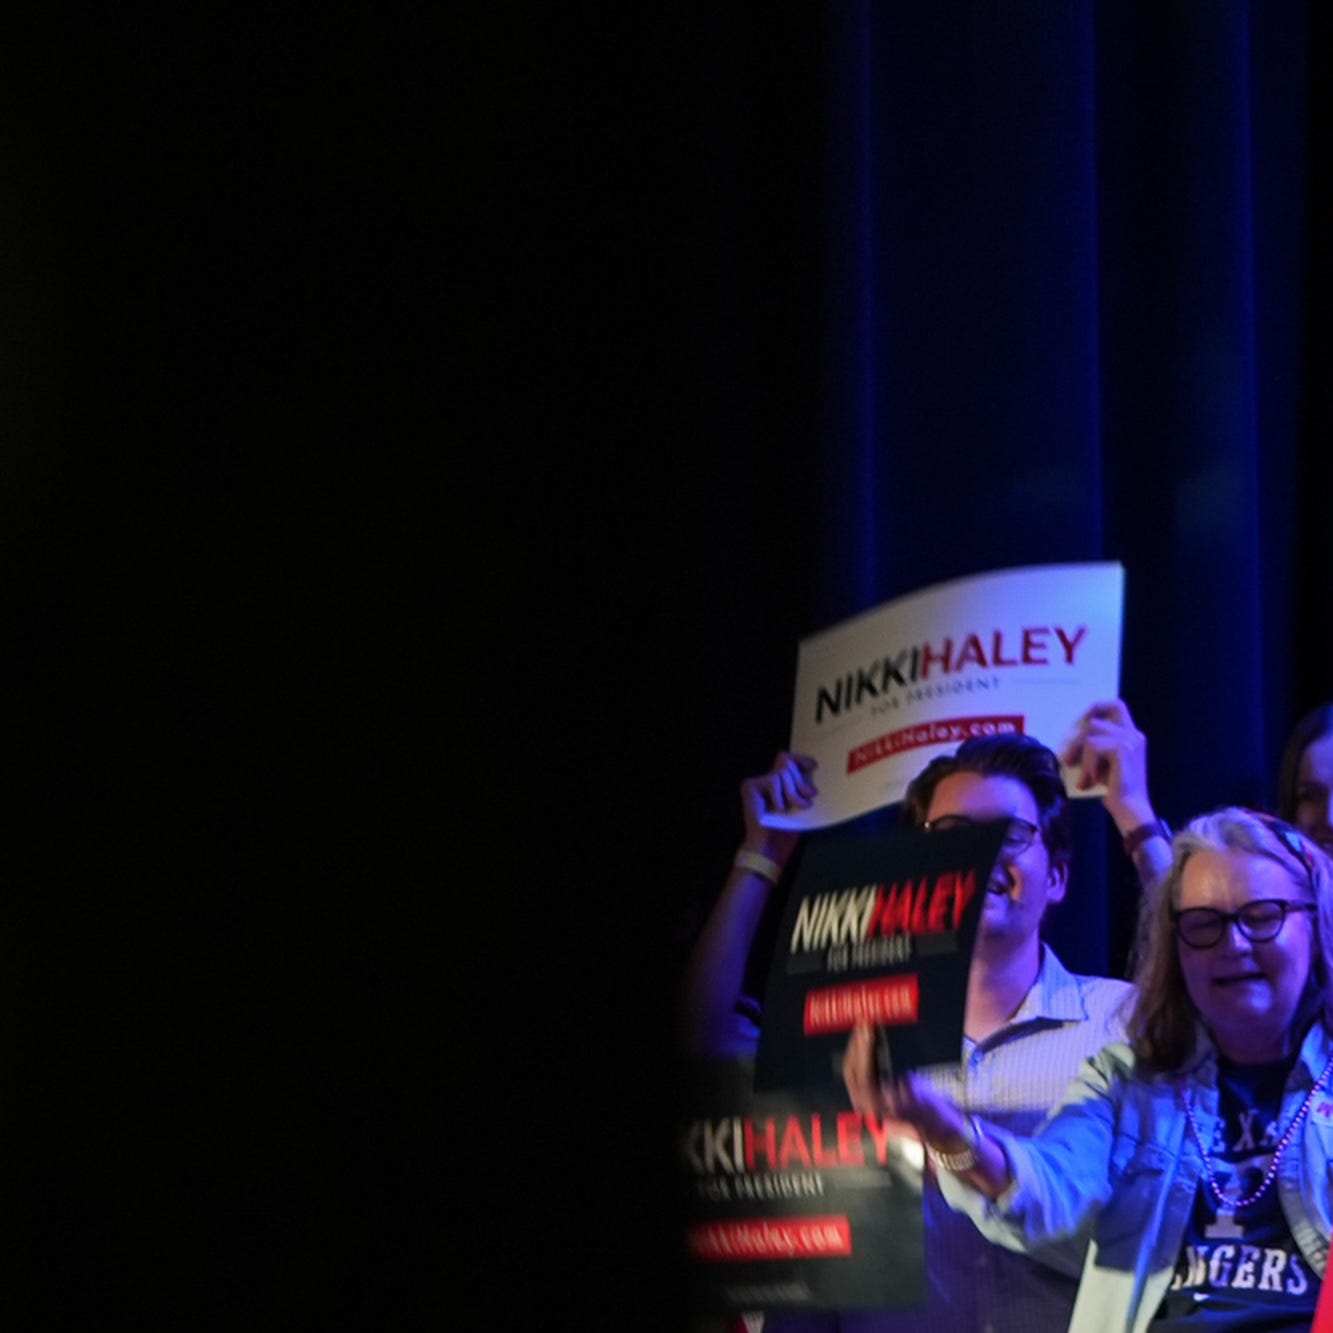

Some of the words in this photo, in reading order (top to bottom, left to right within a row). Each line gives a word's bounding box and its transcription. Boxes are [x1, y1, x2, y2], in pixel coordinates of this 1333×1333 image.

[815, 626, 1087, 724] NIKKIHALEY
[790, 868, 977, 956] NIKKIHALEY
[1171, 1243, 1308, 1295] NGERS
